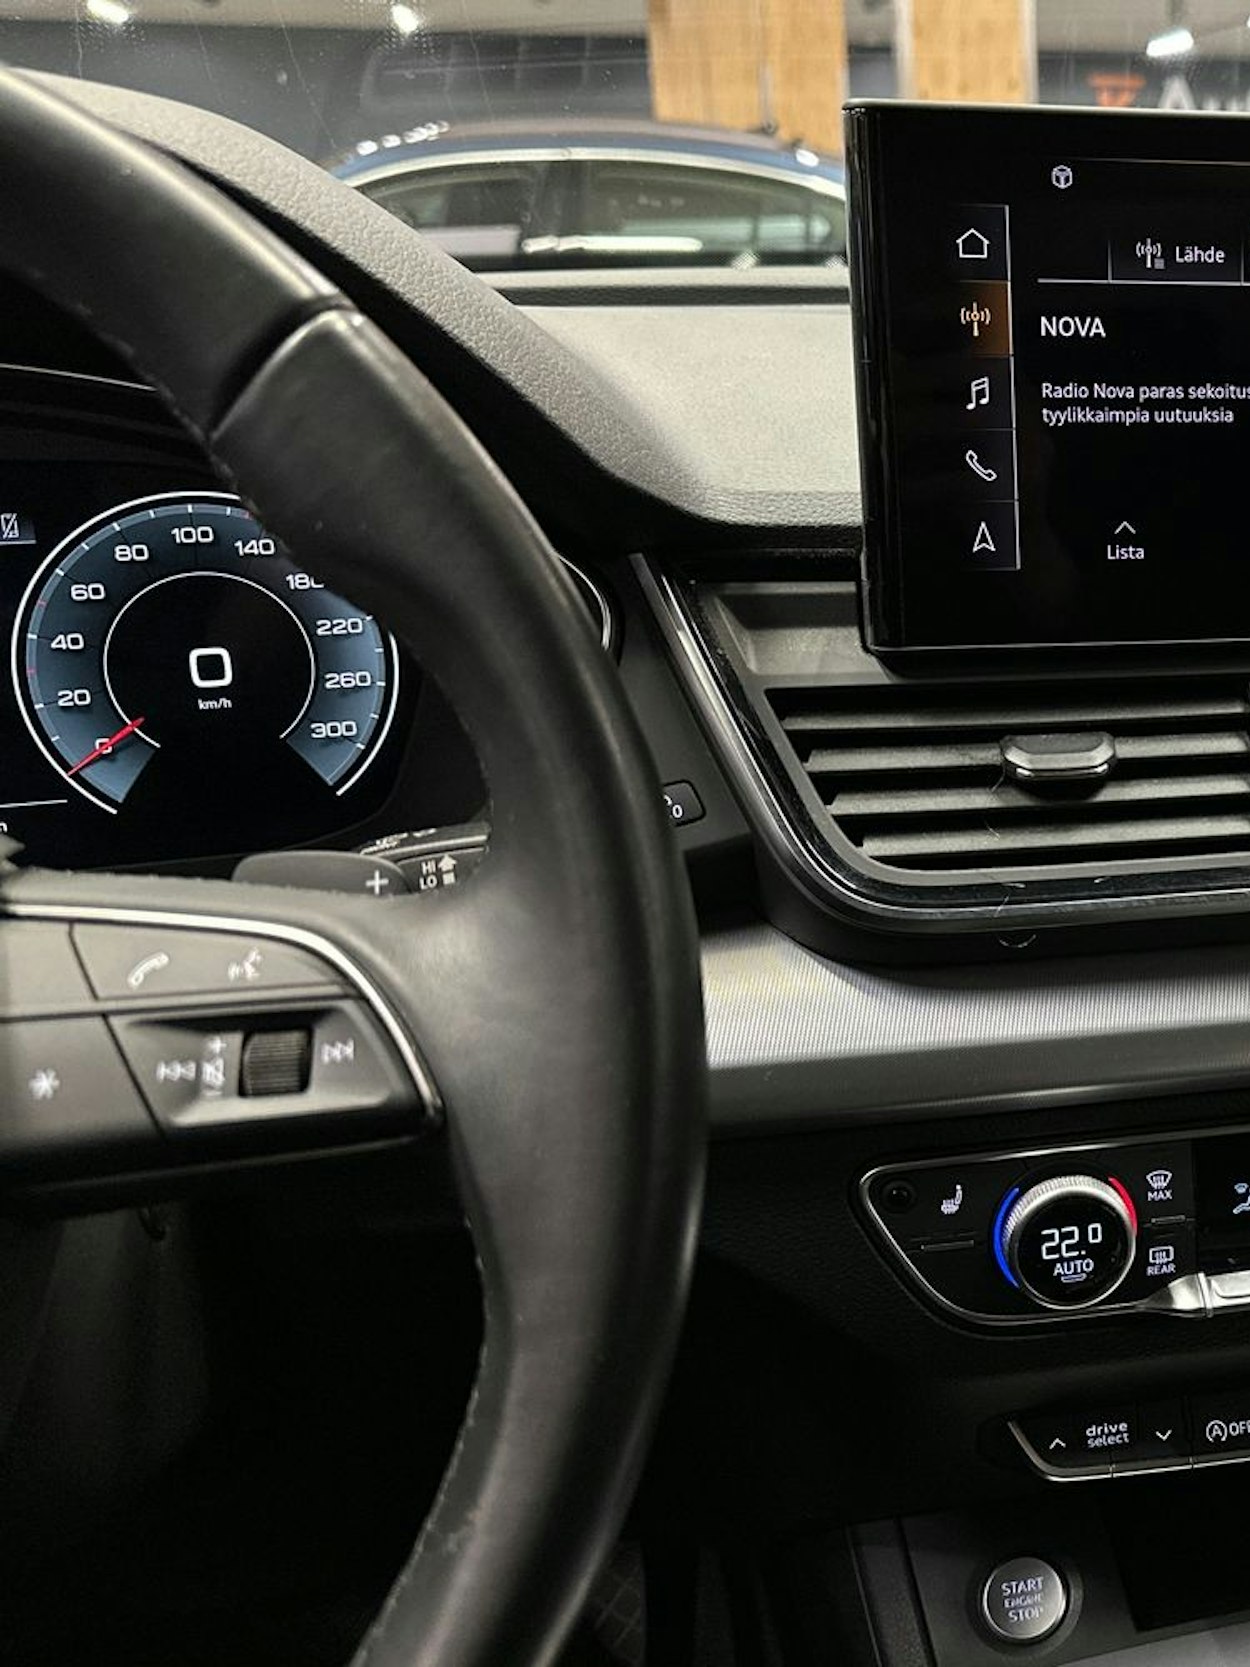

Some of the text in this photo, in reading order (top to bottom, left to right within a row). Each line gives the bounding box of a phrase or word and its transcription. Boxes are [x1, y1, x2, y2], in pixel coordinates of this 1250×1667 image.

[1175, 245, 1226, 265] Lähde
[1040, 316, 1107, 338] NOVA
[1041, 382, 1089, 400] Radio
[1093, 382, 1135, 401] Nova
[1138, 385, 1184, 404] paras
[1041, 405, 1235, 426] tyylikkaimpia uutuuksia
[170, 526, 215, 545] 100
[114, 544, 149, 563] 80
[233, 537, 275, 557] 140
[1106, 544, 1146, 561] Lista
[70, 583, 106, 602] 60
[315, 617, 364, 637] 220
[50, 632, 85, 651] 40
[188, 646, 233, 689] 0
[324, 671, 372, 691] 260
[57, 688, 92, 707] 20
[197, 697, 233, 712] km/h
[310, 720, 358, 739] 300
[421, 859, 437, 876] HI
[419, 873, 438, 891] LO
[1147, 1189, 1174, 1202] MAX
[1052, 1258, 1095, 1277] AUTO
[1146, 1264, 1176, 1277] REAR
[1085, 1421, 1128, 1438] drive
[1086, 1432, 1130, 1449] select
[1001, 1576, 1044, 1596] START
[1008, 1605, 1044, 1622] STOP
